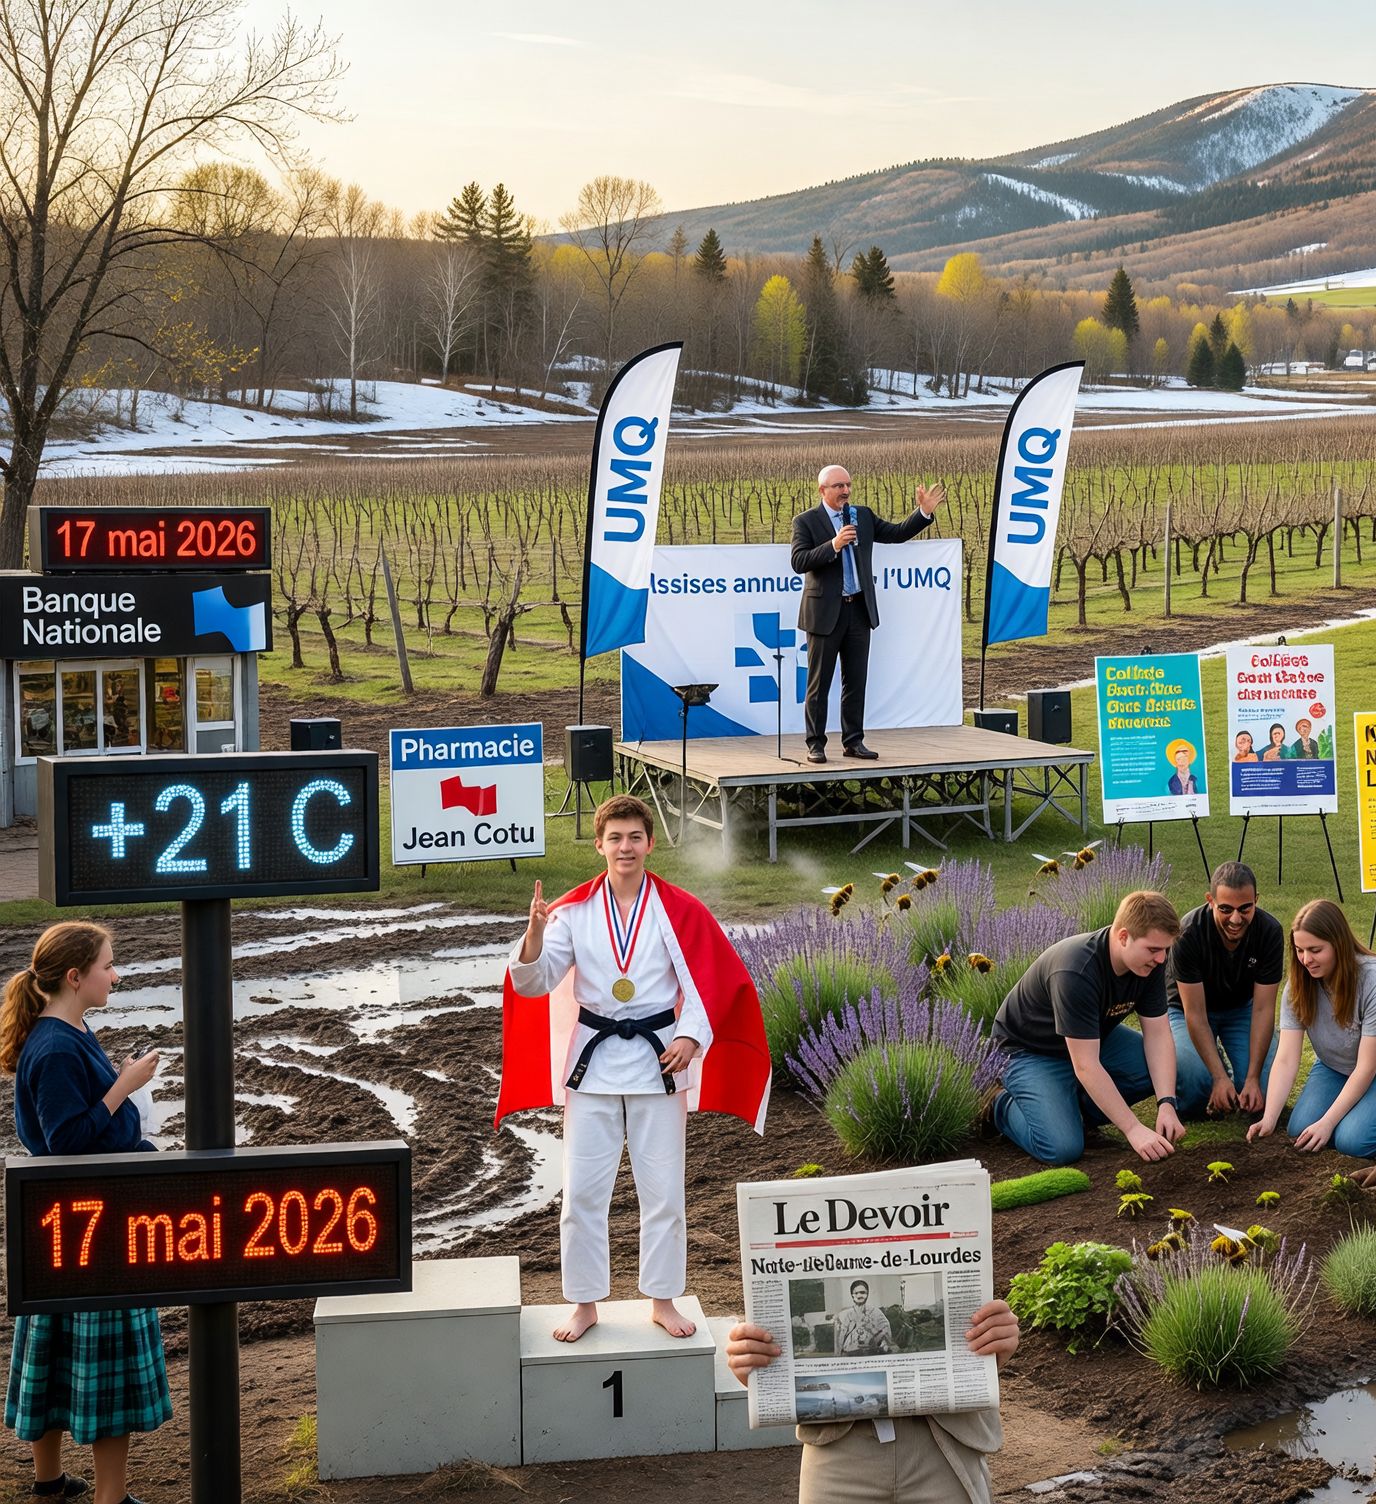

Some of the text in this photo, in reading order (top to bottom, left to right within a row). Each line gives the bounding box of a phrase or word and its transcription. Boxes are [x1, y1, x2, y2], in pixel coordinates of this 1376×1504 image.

[603, 416, 658, 543] UMQ
[1007, 427, 1062, 545] UMQ
[57, 519, 257, 557] 17 mai 2026
[22, 586, 136, 618] Banque
[733, 576, 802, 594] annue
[23, 618, 162, 645] Nationale
[400, 733, 536, 763] Pharmacie
[291, 779, 354, 864] C
[402, 822, 535, 850] Jean Cotu
[41, 1186, 377, 1268] 17 mai 2026
[773, 1193, 950, 1236] Le Devoir
[602, 1370, 624, 1418] 1
